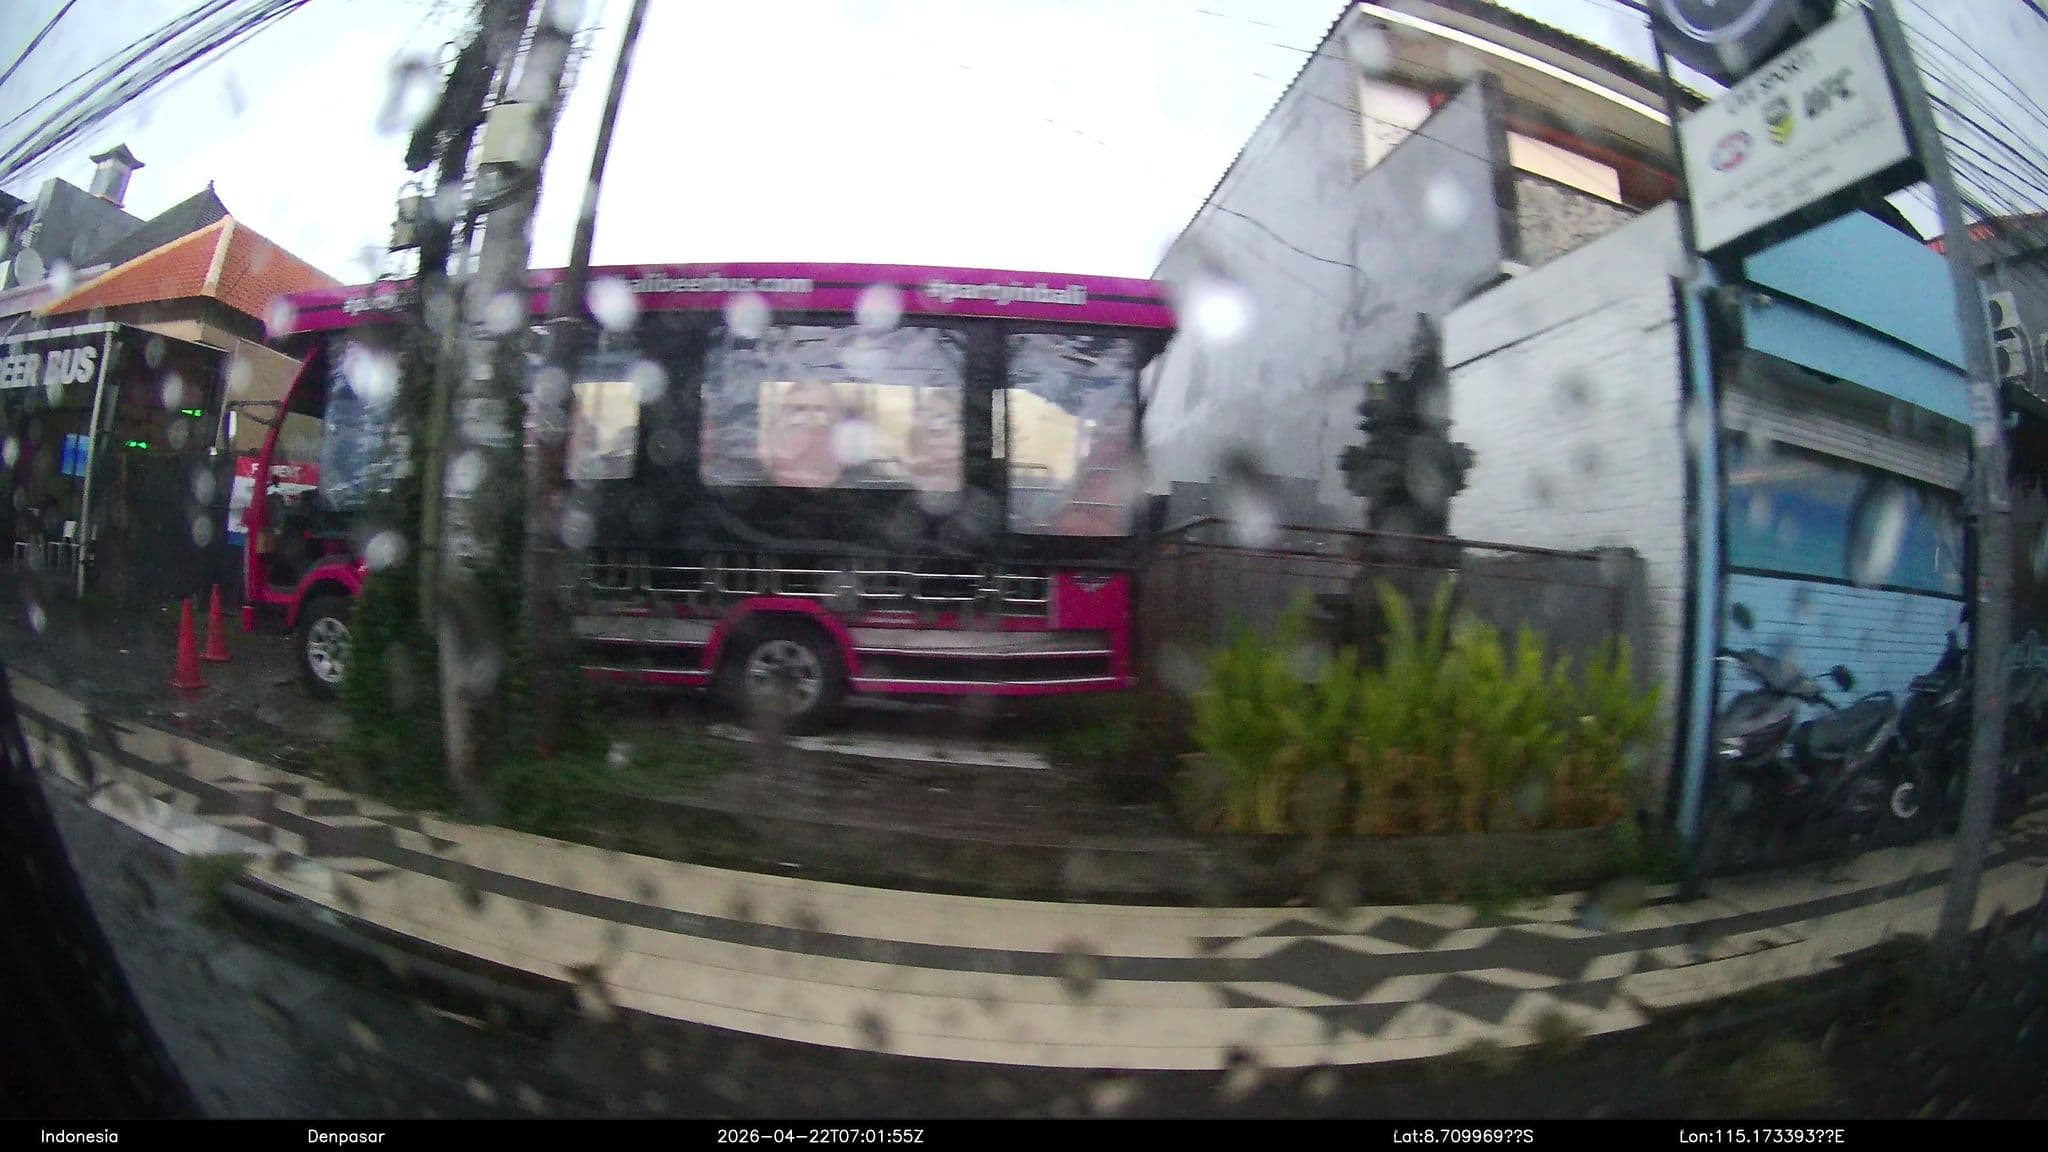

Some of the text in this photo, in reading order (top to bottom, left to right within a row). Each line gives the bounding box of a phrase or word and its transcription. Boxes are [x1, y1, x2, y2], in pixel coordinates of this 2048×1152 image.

[614, 271, 814, 294] alibeerbus.com
[926, 278, 1088, 307] #partyinbali
[0, 345, 98, 390] EER BUS
